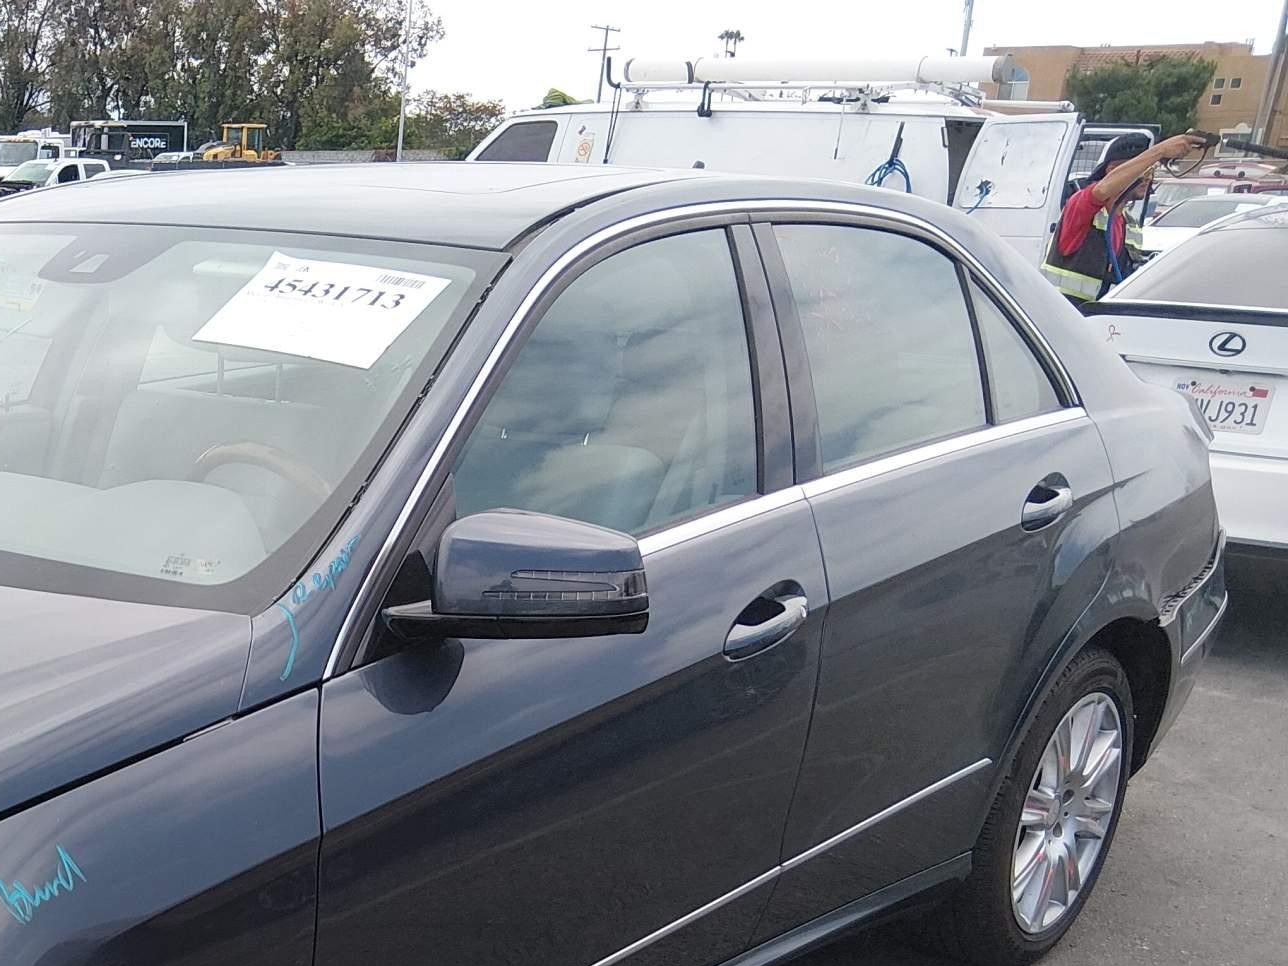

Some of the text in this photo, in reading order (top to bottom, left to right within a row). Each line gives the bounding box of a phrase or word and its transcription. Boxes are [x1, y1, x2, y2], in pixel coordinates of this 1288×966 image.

[131, 138, 166, 148] ENCORE
[264, 277, 406, 310] 45431713
[1191, 382, 1253, 399] California
